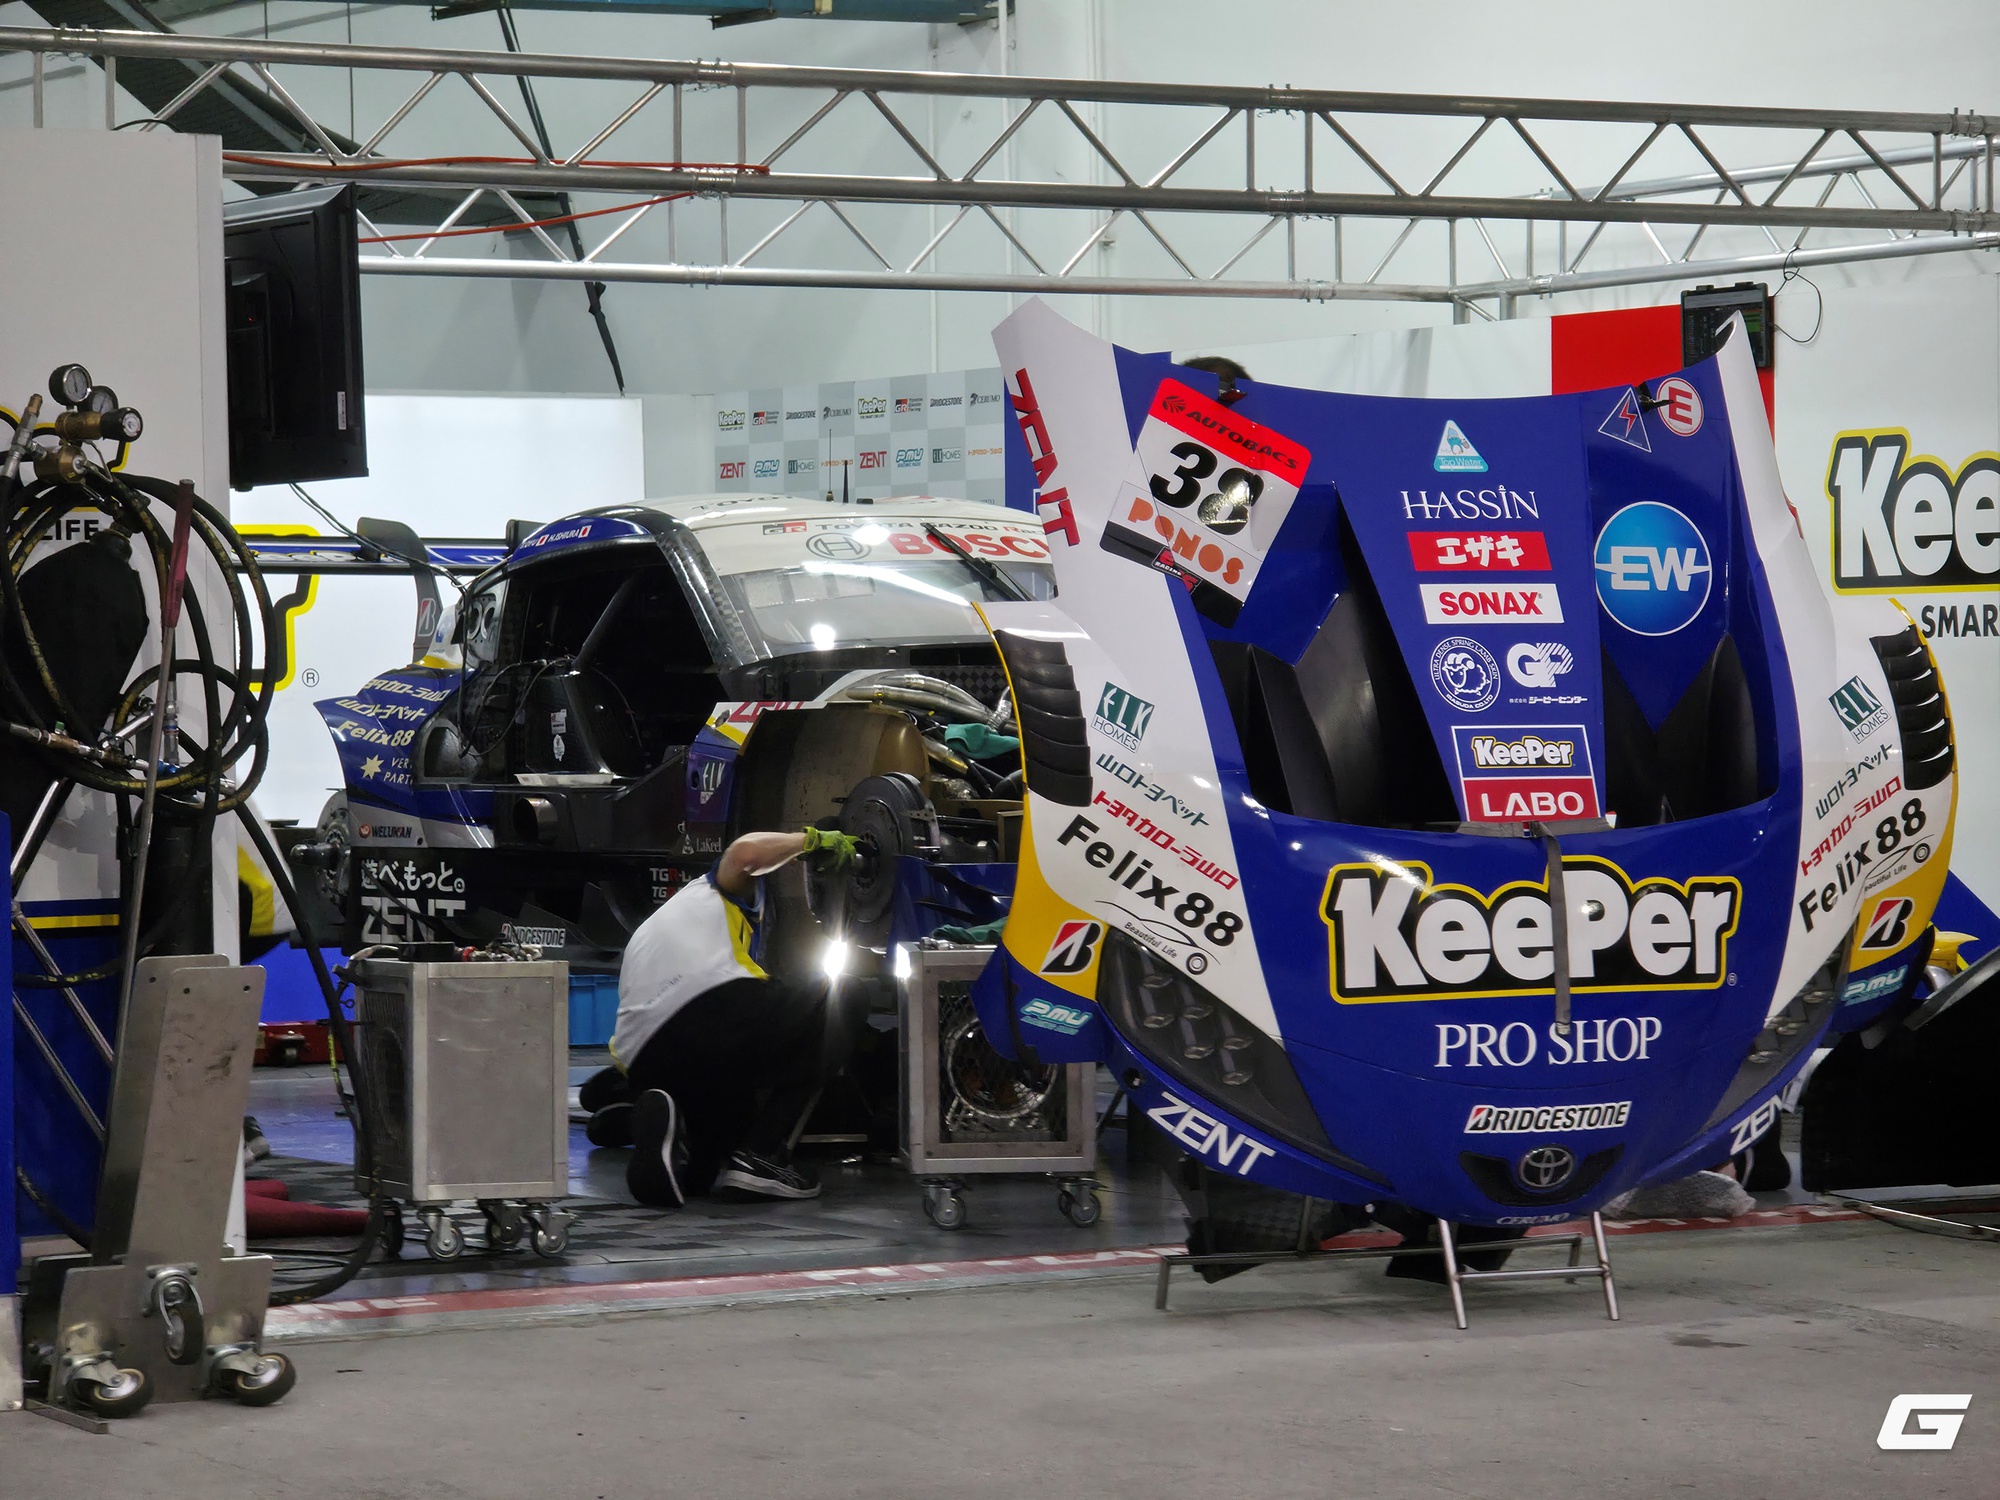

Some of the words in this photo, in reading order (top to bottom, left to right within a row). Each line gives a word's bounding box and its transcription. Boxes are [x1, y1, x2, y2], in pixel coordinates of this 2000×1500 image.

[858, 398, 887, 415] KeePer
[930, 397, 963, 407] BRIDGESTONE
[718, 410, 745, 427] KeePer
[896, 448, 924, 463] PMU
[1186, 410, 1300, 471] AUTOBACS
[720, 462, 745, 479] ZENT
[754, 460, 780, 473] PMU
[860, 451, 887, 469] ZENT
[1149, 441, 1265, 536] 38
[1400, 484, 1540, 520] HASSIN
[41, 519, 100, 541] IFE
[815, 522, 913, 530] TOYTA
[1127, 496, 1244, 585] PONOS
[1436, 535, 1525, 567] エザキ
[1610, 546, 1699, 592] EW
[1438, 591, 1543, 616] SONAX
[1101, 686, 1151, 741] ELK
[1853, 708, 1890, 742] HOMES
[1092, 716, 1138, 751] HOMES
[1473, 738, 1573, 767] KeePer
[1095, 752, 1210, 827] 山口トヨペット
[1481, 792, 1585, 817] LABO
[1864, 871, 1892, 892] eautiful
[1893, 864, 1908, 877] Life
[1124, 921, 1162, 949] Beautiful
[1161, 944, 1178, 959] Life
[1326, 861, 1738, 999] KeePer
[1433, 1022, 1538, 1068] PRO
[1547, 1016, 1663, 1066] SHOP
[1467, 1102, 1630, 1133] BRIDGESTONE
[1147, 1092, 1276, 1176] ZENT
